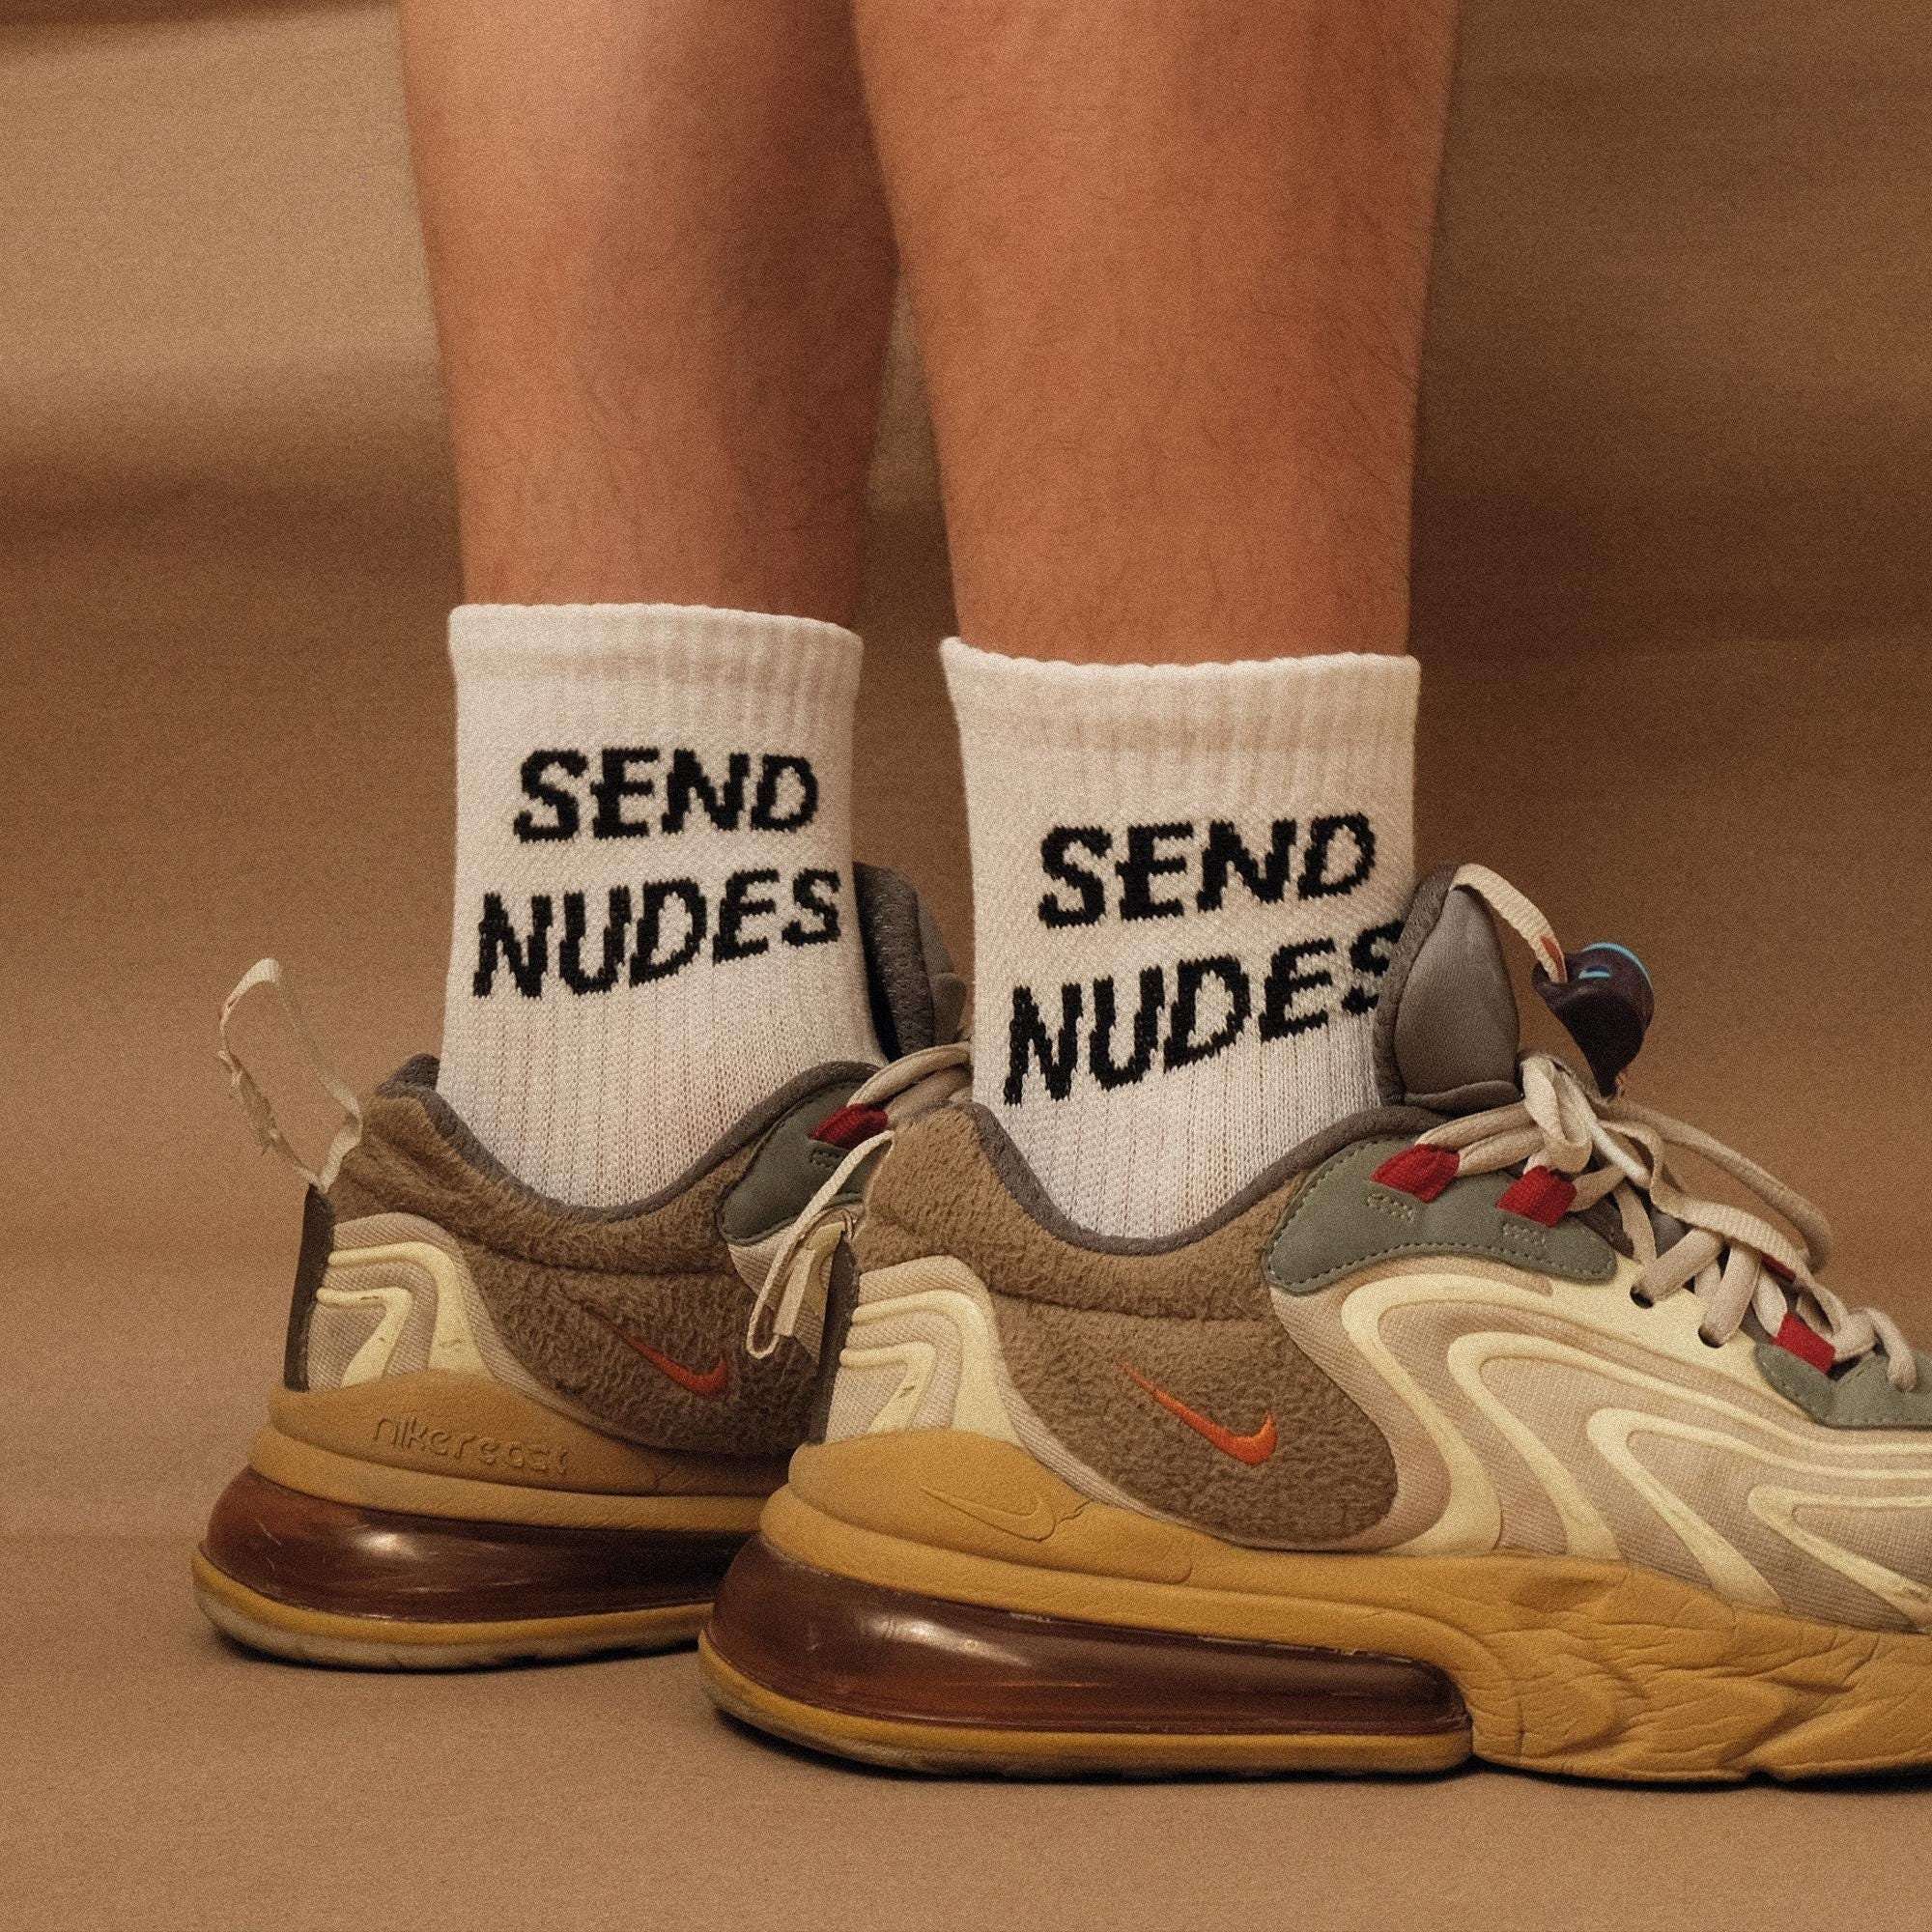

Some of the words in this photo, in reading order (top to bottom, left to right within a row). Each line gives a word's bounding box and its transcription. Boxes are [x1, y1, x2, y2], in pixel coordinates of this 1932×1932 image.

[514, 748, 819, 842] SEND
[1038, 812, 1377, 928] SEND
[473, 868, 841, 998] NUDES
[1004, 921, 1405, 1107] NUDES
